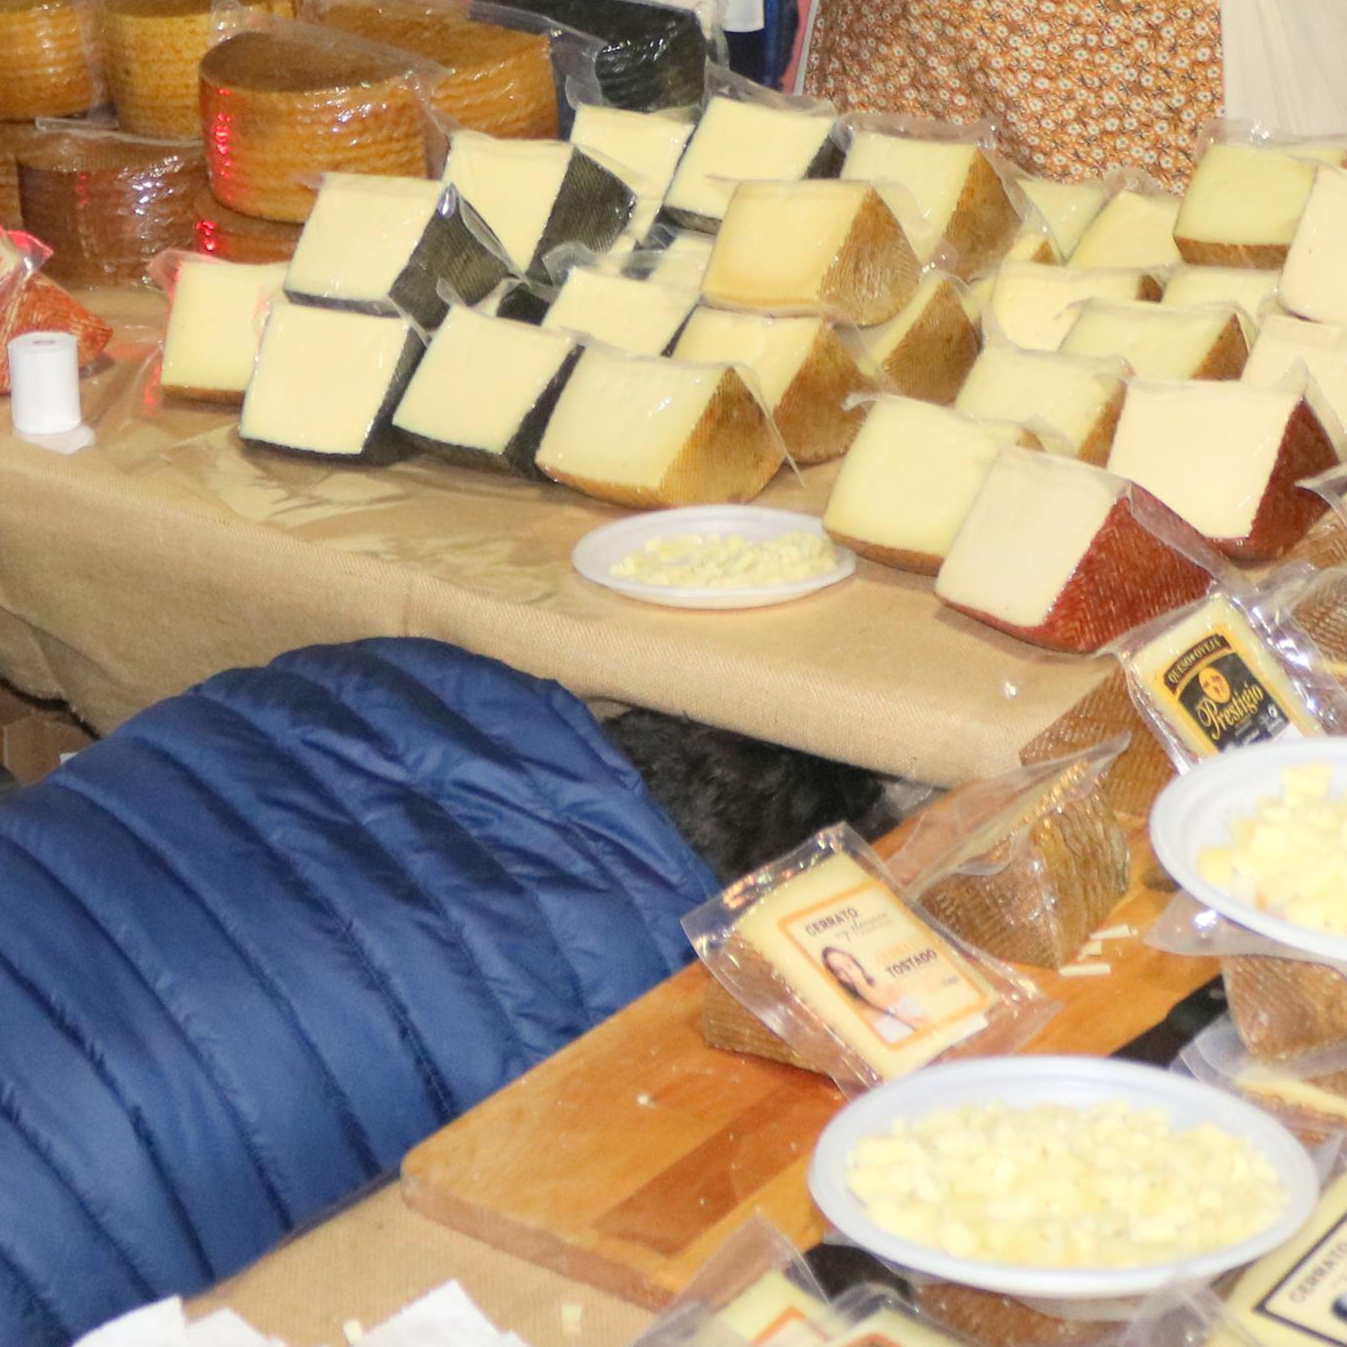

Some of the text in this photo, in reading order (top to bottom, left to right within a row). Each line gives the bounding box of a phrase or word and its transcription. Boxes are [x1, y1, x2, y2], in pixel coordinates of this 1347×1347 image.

[1195, 682, 1265, 740] Prestigio
[804, 906, 859, 937] CERRATO
[884, 947, 938, 979] TOSTADO
